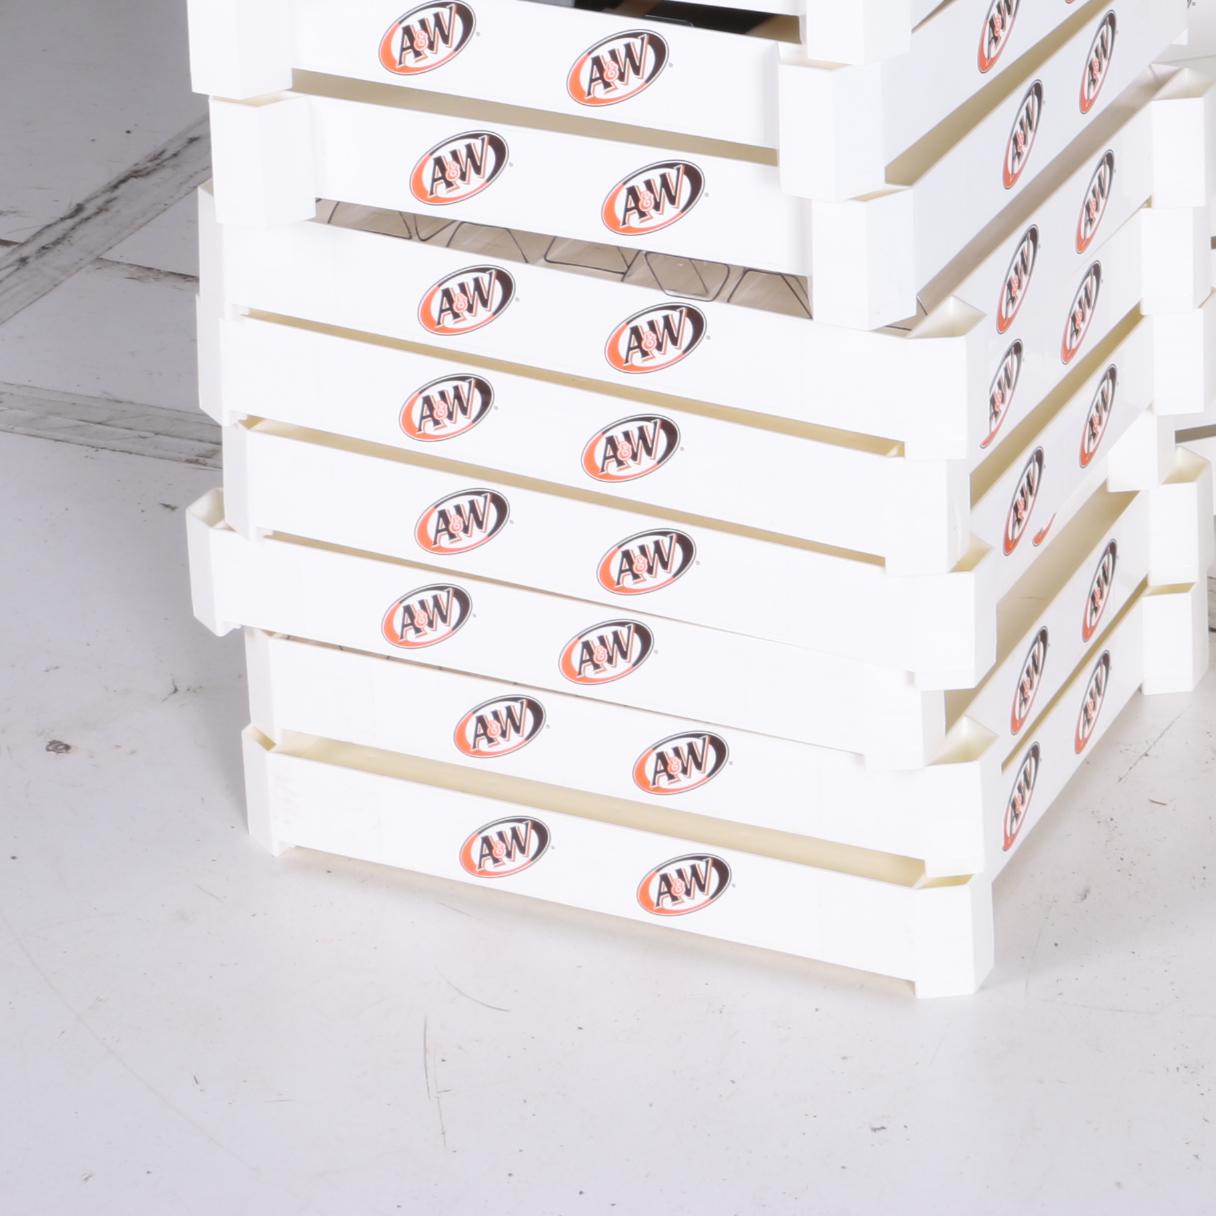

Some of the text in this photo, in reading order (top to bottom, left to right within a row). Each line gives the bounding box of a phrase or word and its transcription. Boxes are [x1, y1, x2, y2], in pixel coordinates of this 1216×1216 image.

[396, 3, 457, 68] A&W
[585, 34, 649, 99] A&W
[428, 134, 489, 199] A&W
[620, 164, 685, 229] A&W
[435, 269, 497, 328] A&W
[623, 307, 687, 367] A&W
[416, 378, 476, 435] A&W
[599, 418, 661, 475] A&W
[431, 492, 491, 548] A&W
[614, 533, 677, 588] A&W
[398, 587, 454, 642] A&W
[576, 623, 635, 678] A&W
[471, 699, 527, 752] A&W
[650, 735, 710, 788] A&W
[476, 820, 532, 871] A&W
[654, 857, 713, 909] A&W
